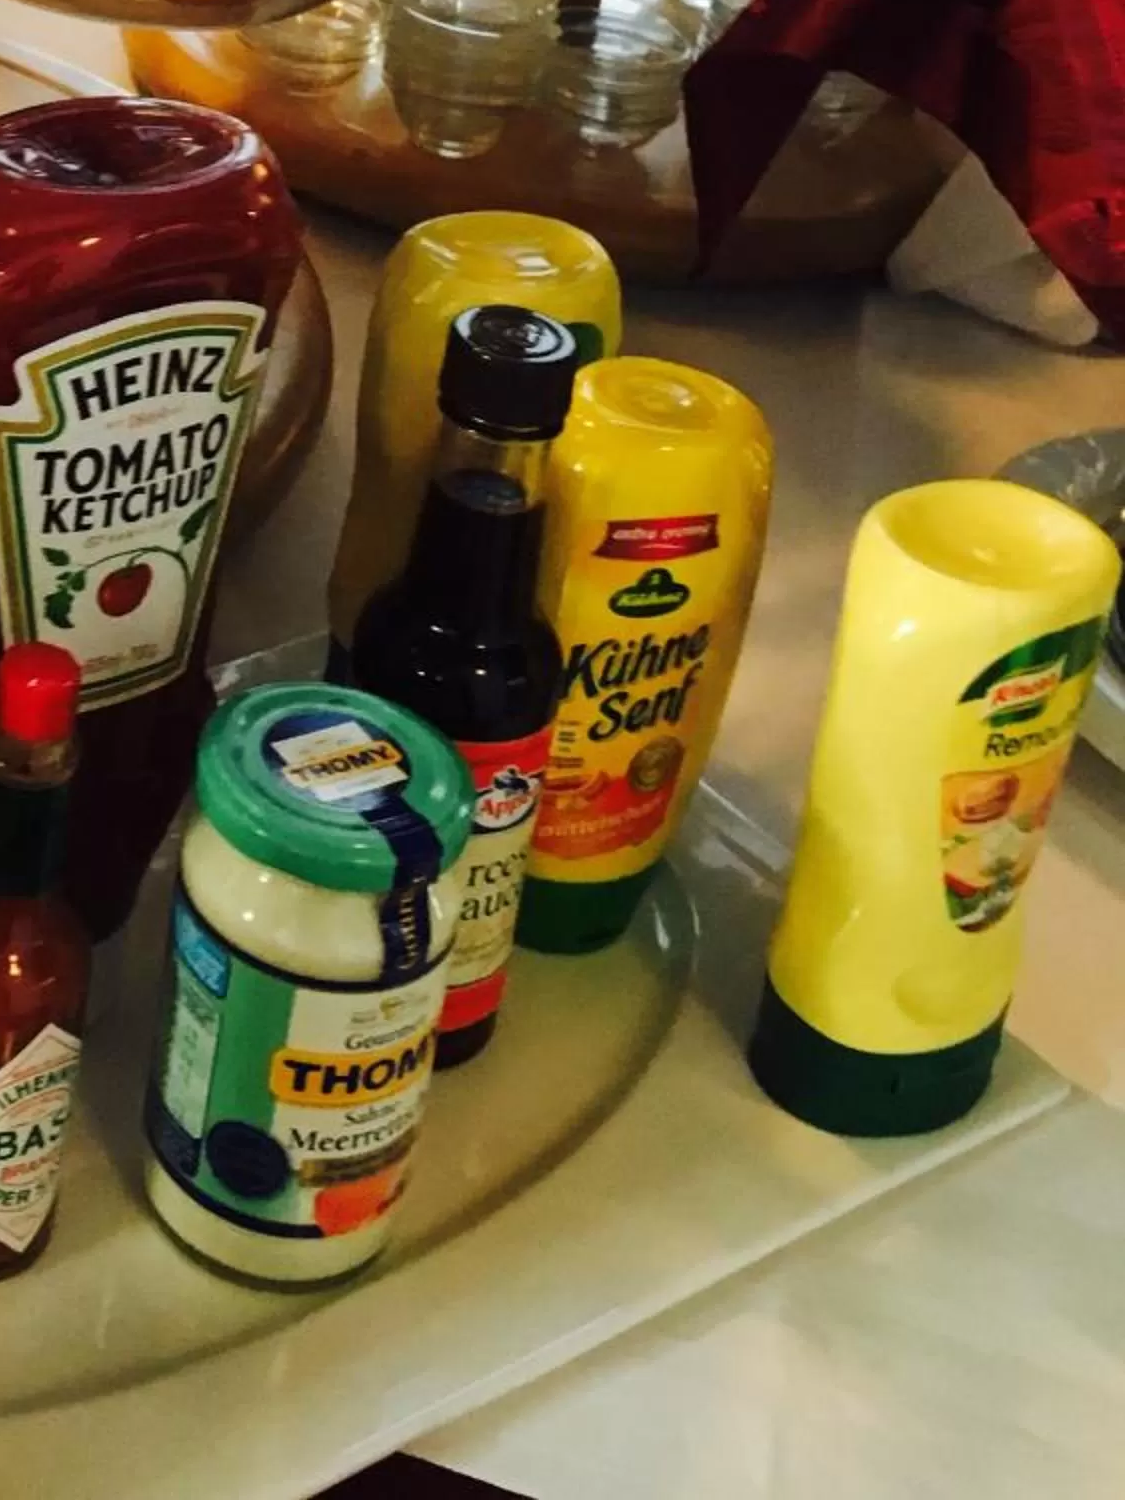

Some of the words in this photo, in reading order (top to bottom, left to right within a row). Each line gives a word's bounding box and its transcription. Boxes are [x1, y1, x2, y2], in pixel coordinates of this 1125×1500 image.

[70, 348, 225, 419] HEINZ
[35, 414, 229, 496] TOMATO
[41, 463, 216, 534] KETCHUP
[559, 624, 710, 698] Kühne
[588, 660, 704, 741] Senf
[290, 745, 390, 782] THOMY
[283, 1032, 429, 1095] THOM
